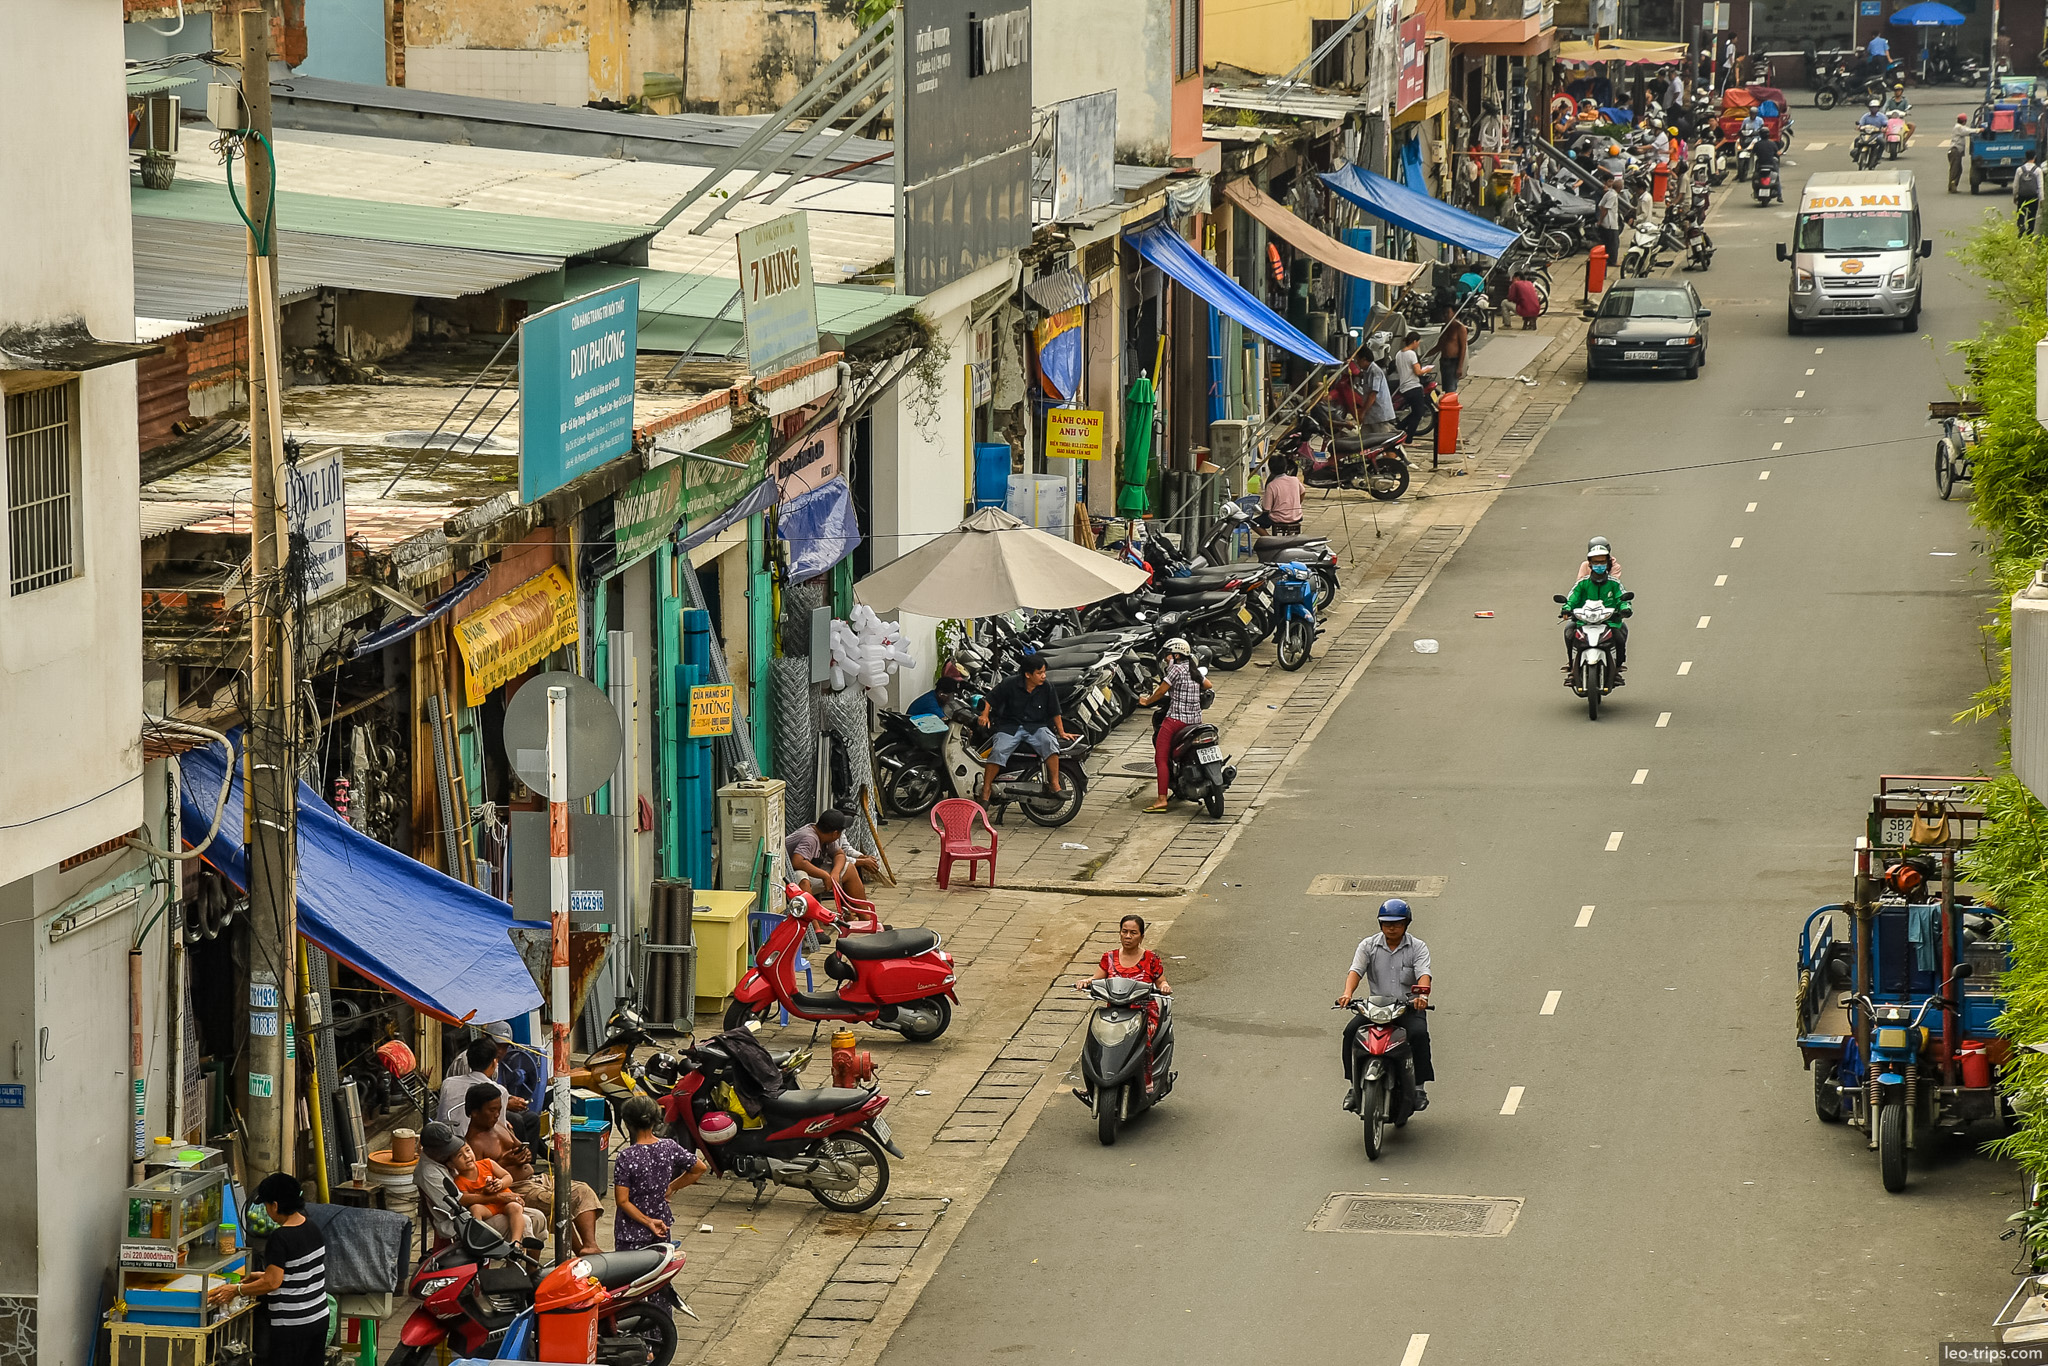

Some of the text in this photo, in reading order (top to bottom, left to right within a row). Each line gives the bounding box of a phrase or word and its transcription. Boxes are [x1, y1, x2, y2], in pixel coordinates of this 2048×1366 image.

[1809, 195, 1902, 209] HOA MAI
[750, 260, 759, 305] 7
[570, 329, 625, 380] DUY PHƯƠNG
[1052, 414, 1099, 426] BÁNH CANH
[1059, 428, 1076, 436] ANH
[692, 699, 730, 715] 7 MỪNG
